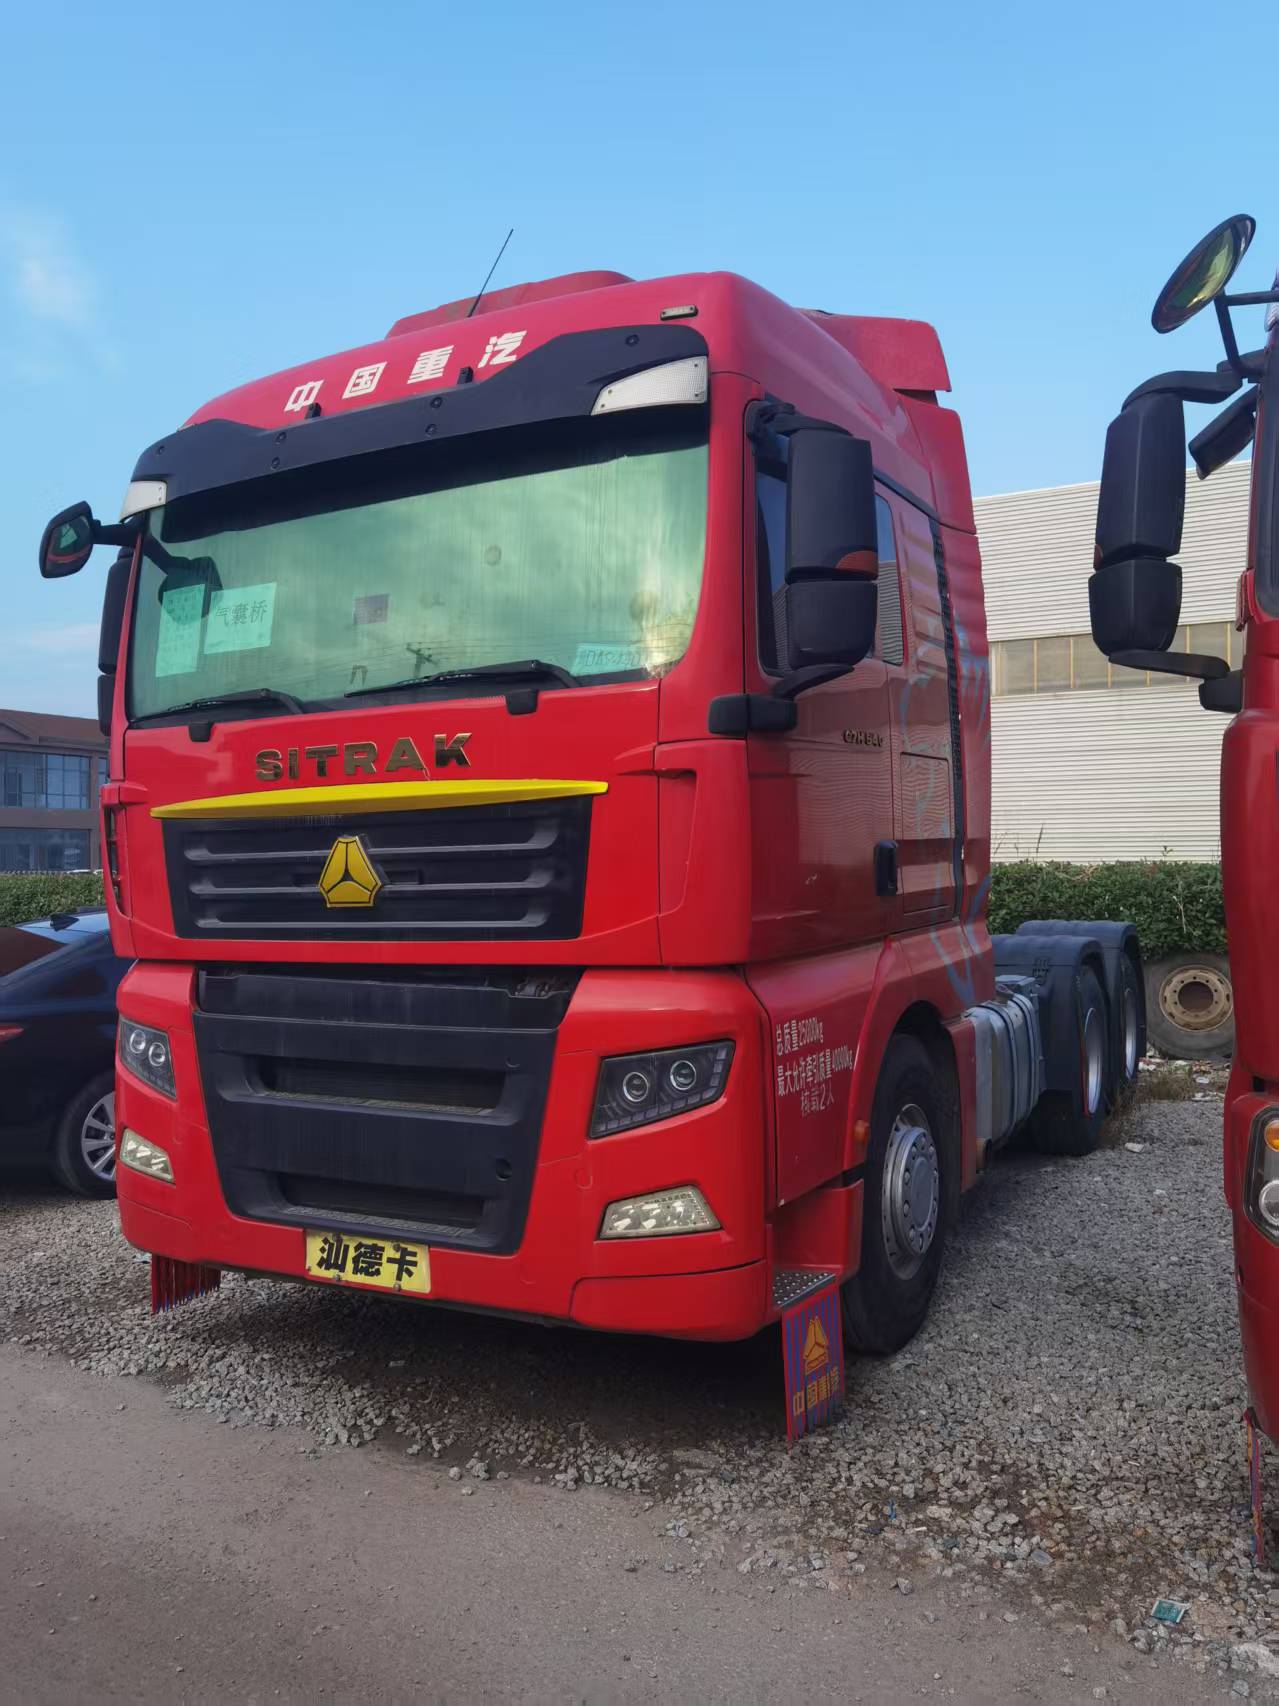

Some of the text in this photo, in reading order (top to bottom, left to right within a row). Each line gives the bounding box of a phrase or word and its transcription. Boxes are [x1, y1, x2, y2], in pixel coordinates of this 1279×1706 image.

[284, 331, 527, 412] 中国重汽
[255, 732, 472, 782] SITRAK
[316, 1232, 417, 1281] 汕德卡
